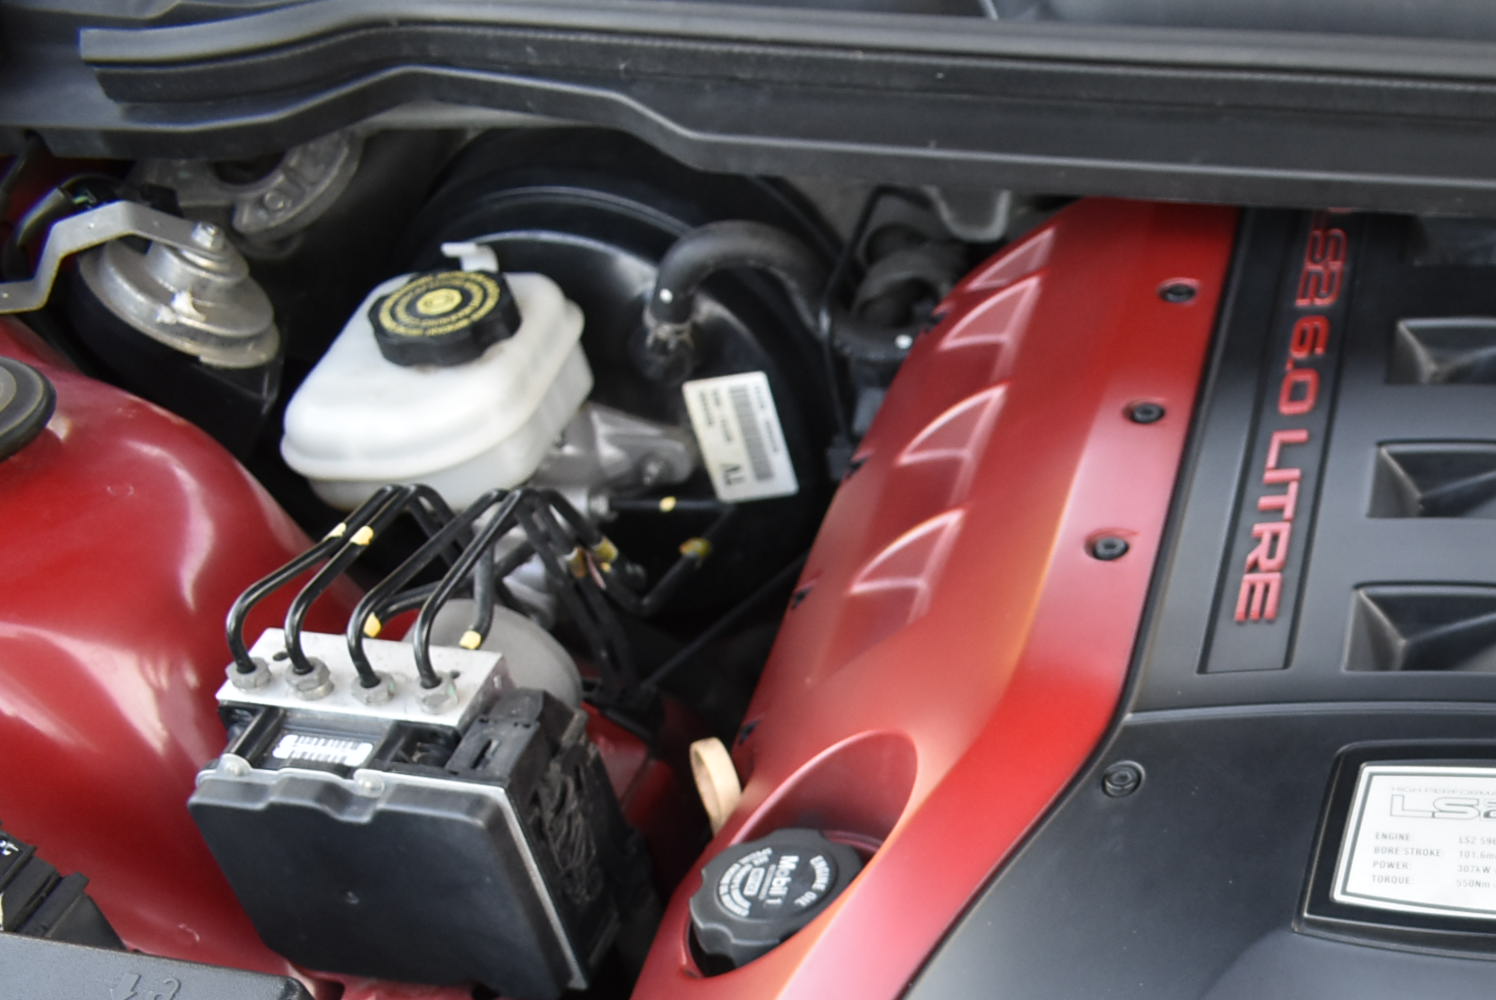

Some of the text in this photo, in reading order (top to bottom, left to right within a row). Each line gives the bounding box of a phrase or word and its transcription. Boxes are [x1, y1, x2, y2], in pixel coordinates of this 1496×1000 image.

[1278, 315, 1330, 414] 6.0
[1234, 429, 1309, 622] LITRE
[768, 855, 800, 896] Mobil
[794, 855, 830, 908] ENGINE OIL
